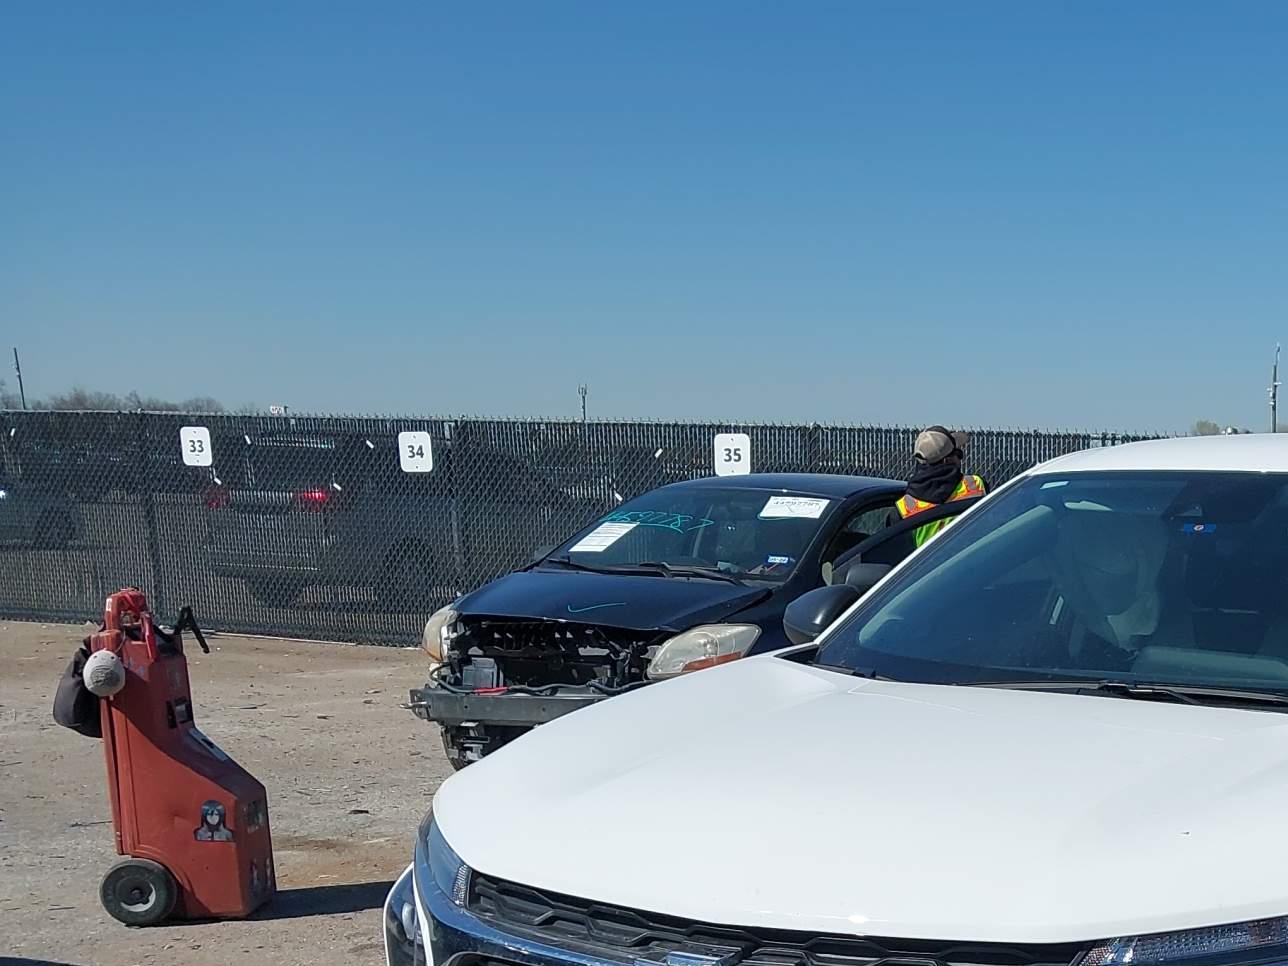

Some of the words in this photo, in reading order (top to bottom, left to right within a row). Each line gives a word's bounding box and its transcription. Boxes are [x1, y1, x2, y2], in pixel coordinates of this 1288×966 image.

[189, 440, 204, 453] 33
[408, 445, 424, 459] 34
[724, 448, 741, 462] 35
